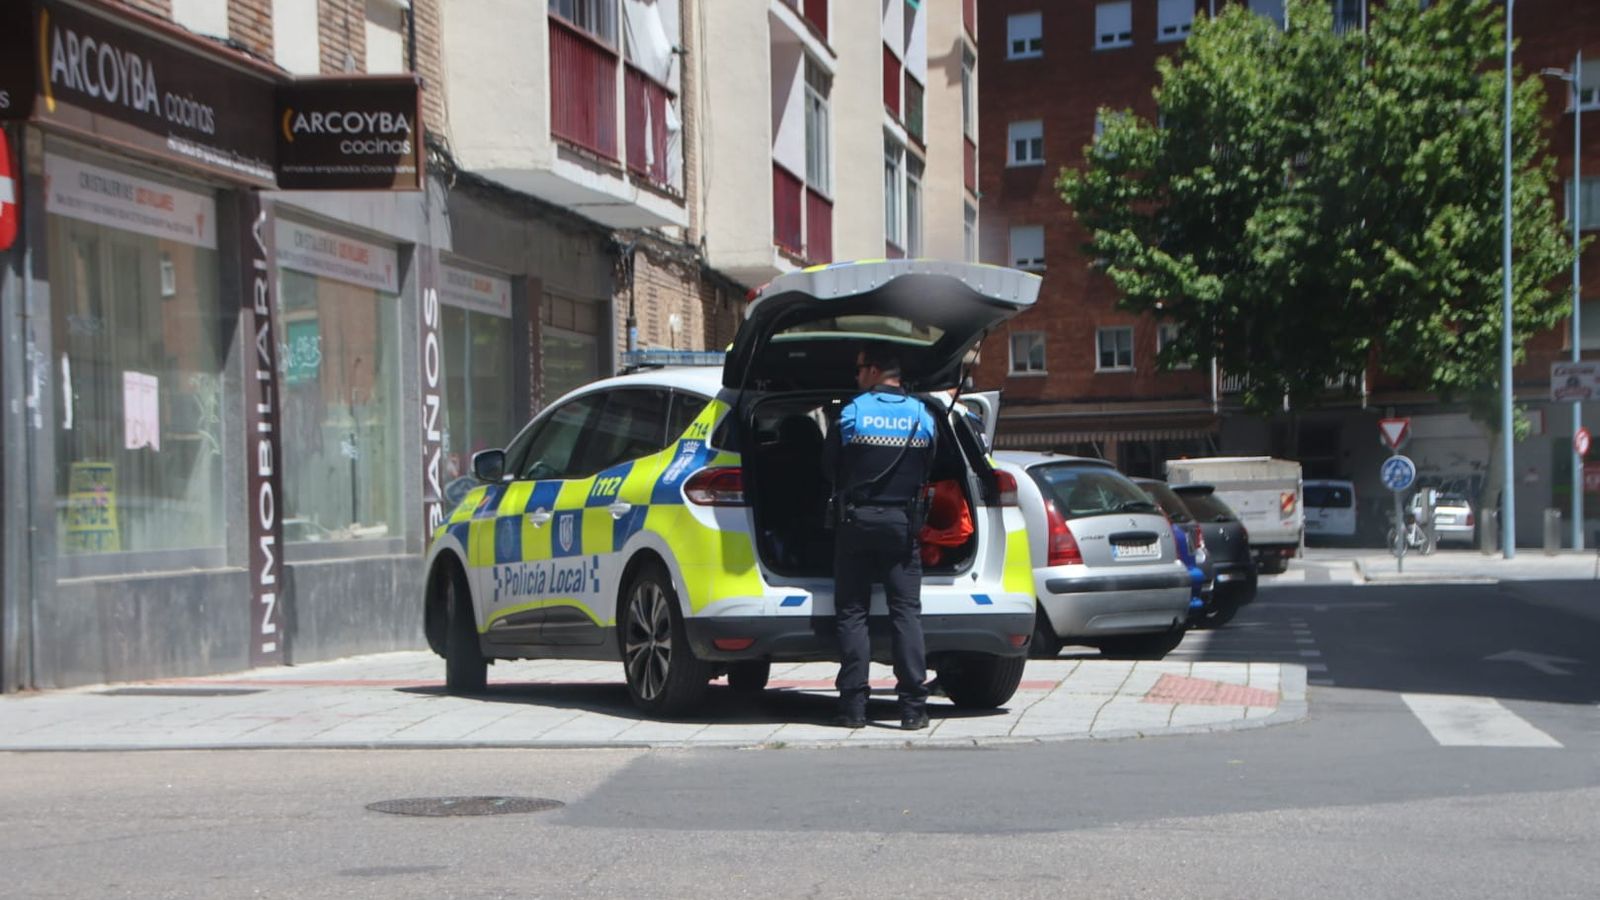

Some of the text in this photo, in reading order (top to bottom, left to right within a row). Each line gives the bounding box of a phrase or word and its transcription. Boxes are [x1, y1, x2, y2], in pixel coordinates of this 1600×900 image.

[51, 25, 215, 135] ARCOYBA cocinas
[293, 111, 411, 134] ARCOYBA
[340, 137, 411, 154] cocinas
[253, 210, 277, 653] INMOBILIARIA
[594, 476, 622, 497] 112
[504, 560, 587, 596] Policía Local
